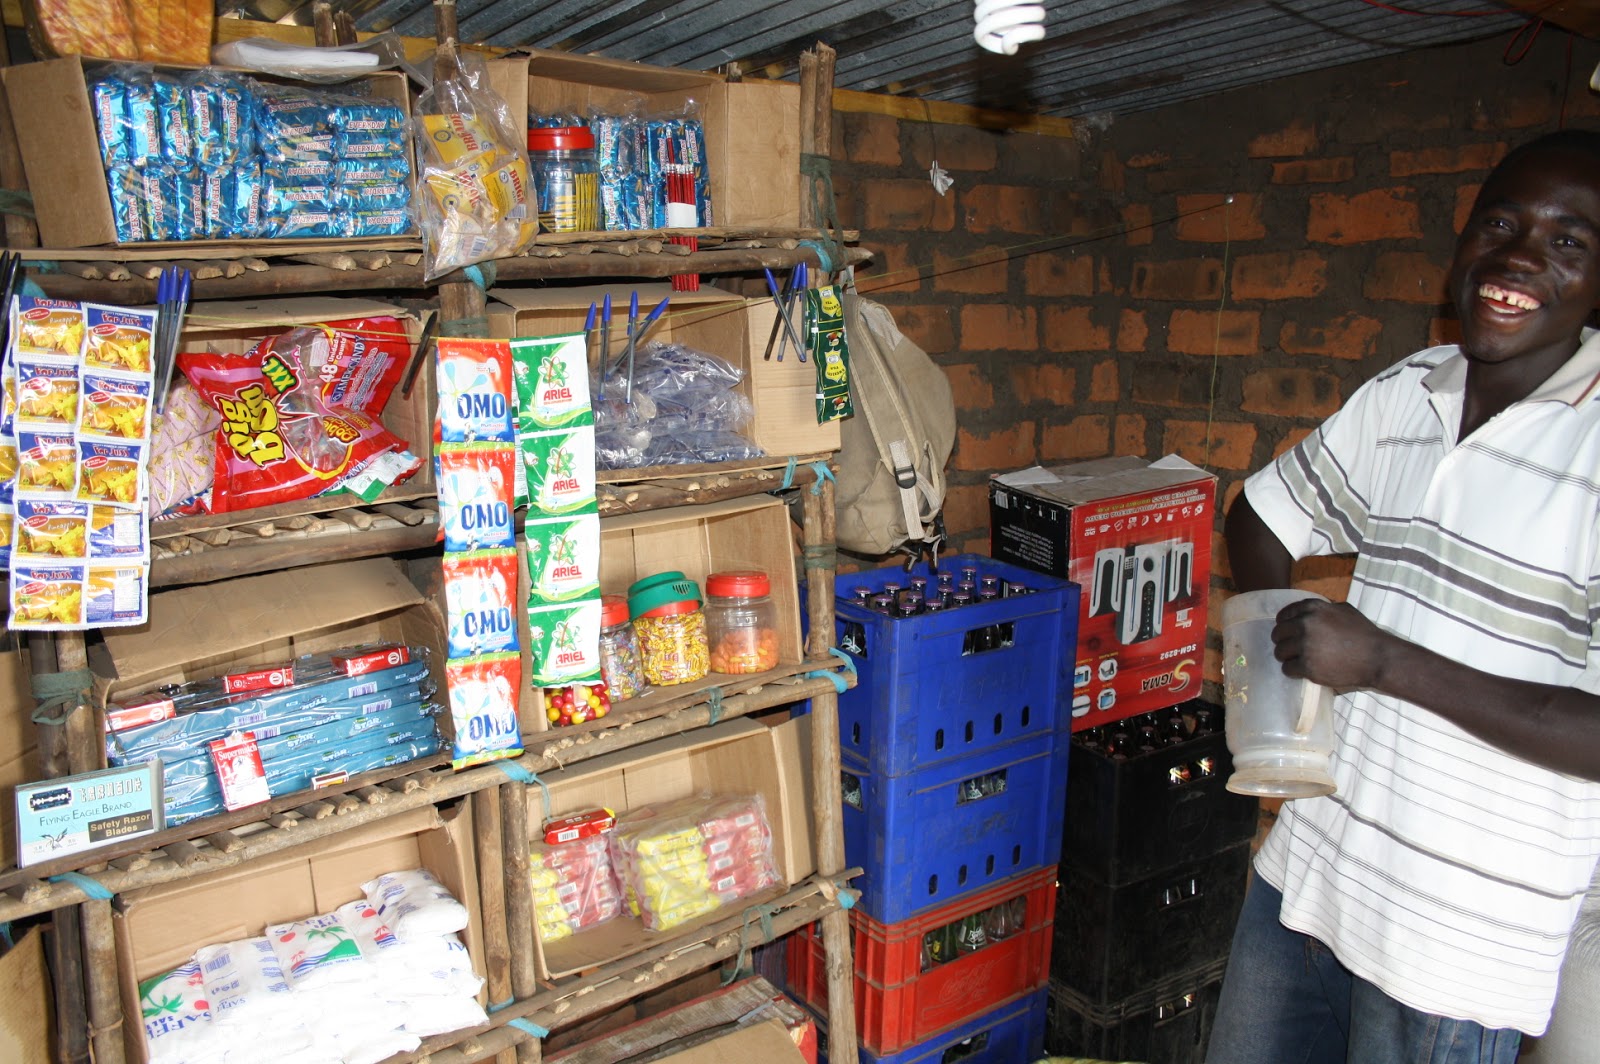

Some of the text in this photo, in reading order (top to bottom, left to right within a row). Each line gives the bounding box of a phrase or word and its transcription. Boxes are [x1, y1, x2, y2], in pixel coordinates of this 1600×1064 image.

[347, 143, 386, 153] EVERYDAY
[261, 355, 297, 393] XXL
[320, 364, 338, 384] 48
[543, 387, 573, 402] ARIEL
[456, 393, 506, 420] OMO
[552, 478, 580, 492] ARIEL
[461, 501, 508, 531] OMO
[552, 564, 582, 579] ARIEL
[463, 607, 511, 639] OMO
[555, 650, 585, 664] ARIEL
[1158, 642, 1198, 661] SGM-8292
[1140, 658, 1197, 694] SIGMA
[353, 717, 383, 731] STAR
[468, 711, 516, 742] OMO
[216, 743, 258, 763] Supermatch
[39, 801, 133, 827] FLYING EAGLE BRAND
[90, 812, 152, 832] Safety Razor
[105, 824, 139, 838] Blades
